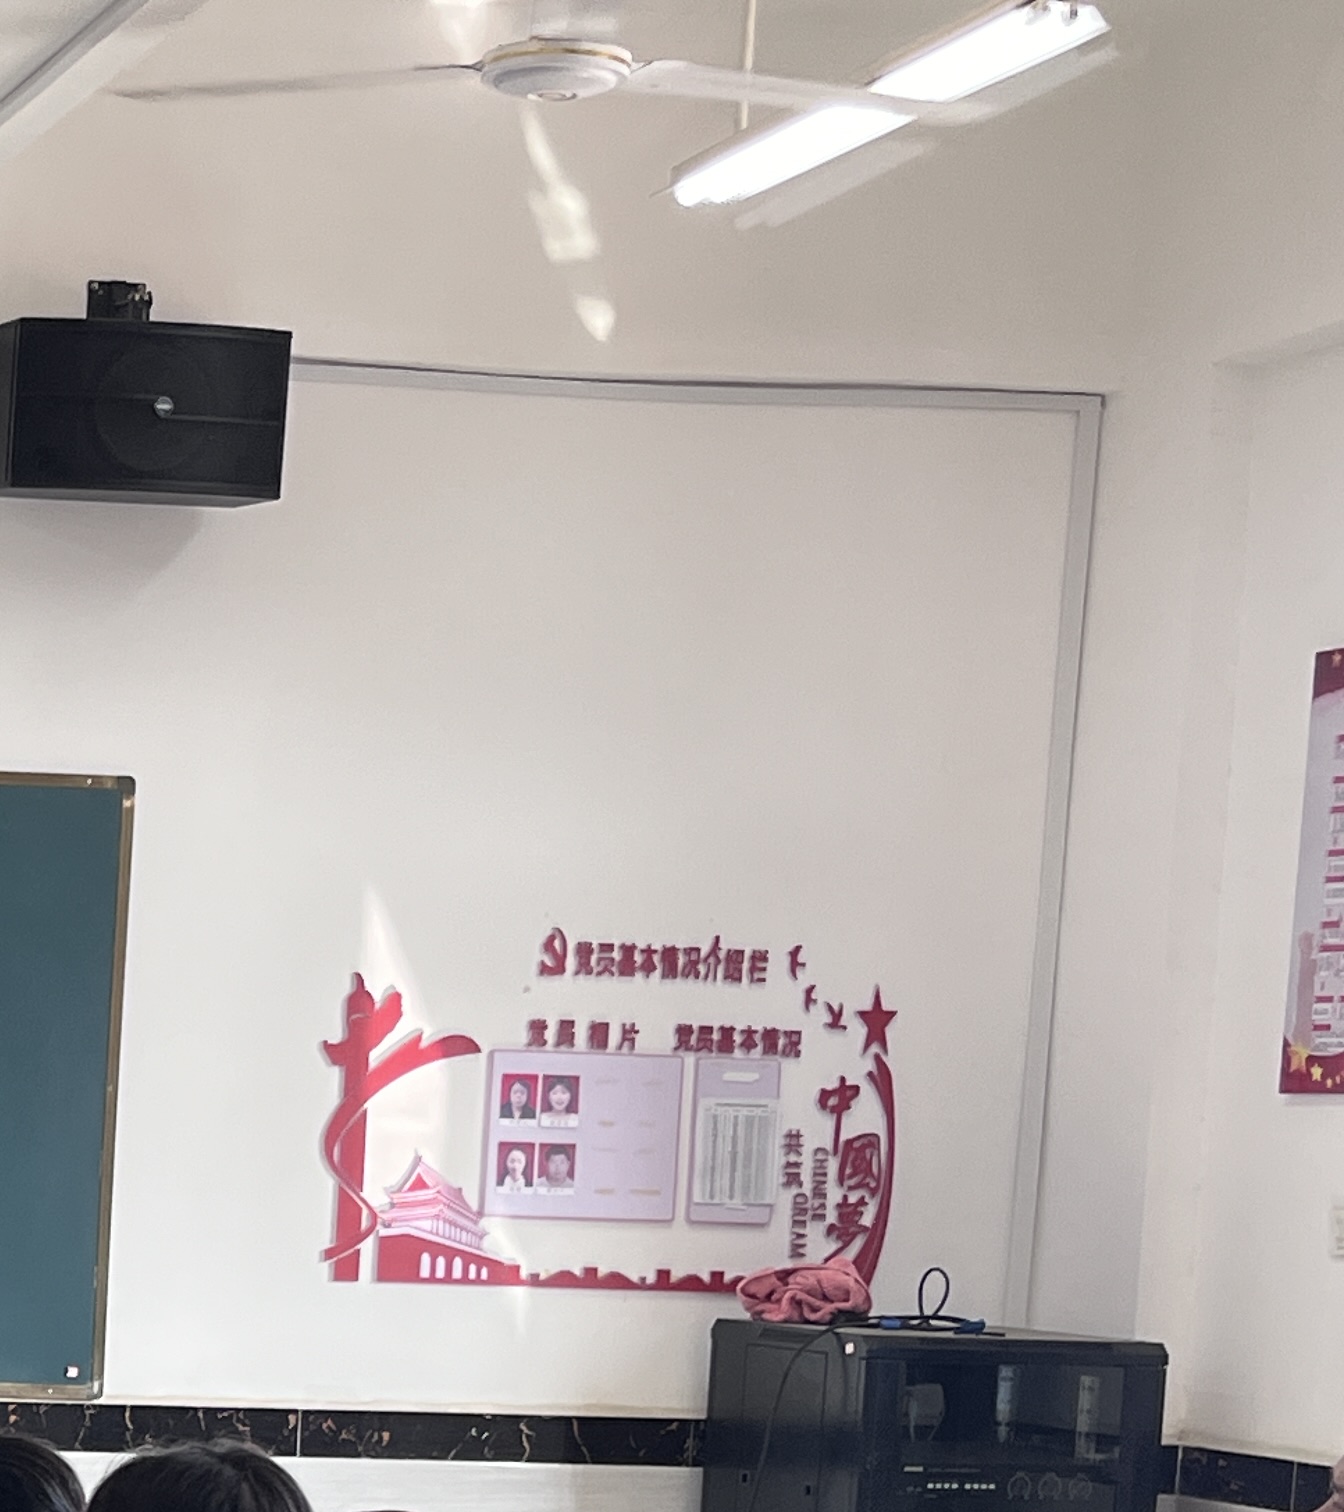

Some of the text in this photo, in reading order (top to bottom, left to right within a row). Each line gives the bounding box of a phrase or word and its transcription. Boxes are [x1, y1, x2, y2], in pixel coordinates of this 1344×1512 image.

[574, 935, 769, 983] 党员基本情况介绍栏
[674, 1024, 803, 1058] 党员基本情况
[811, 1146, 830, 1223] CHINESE
